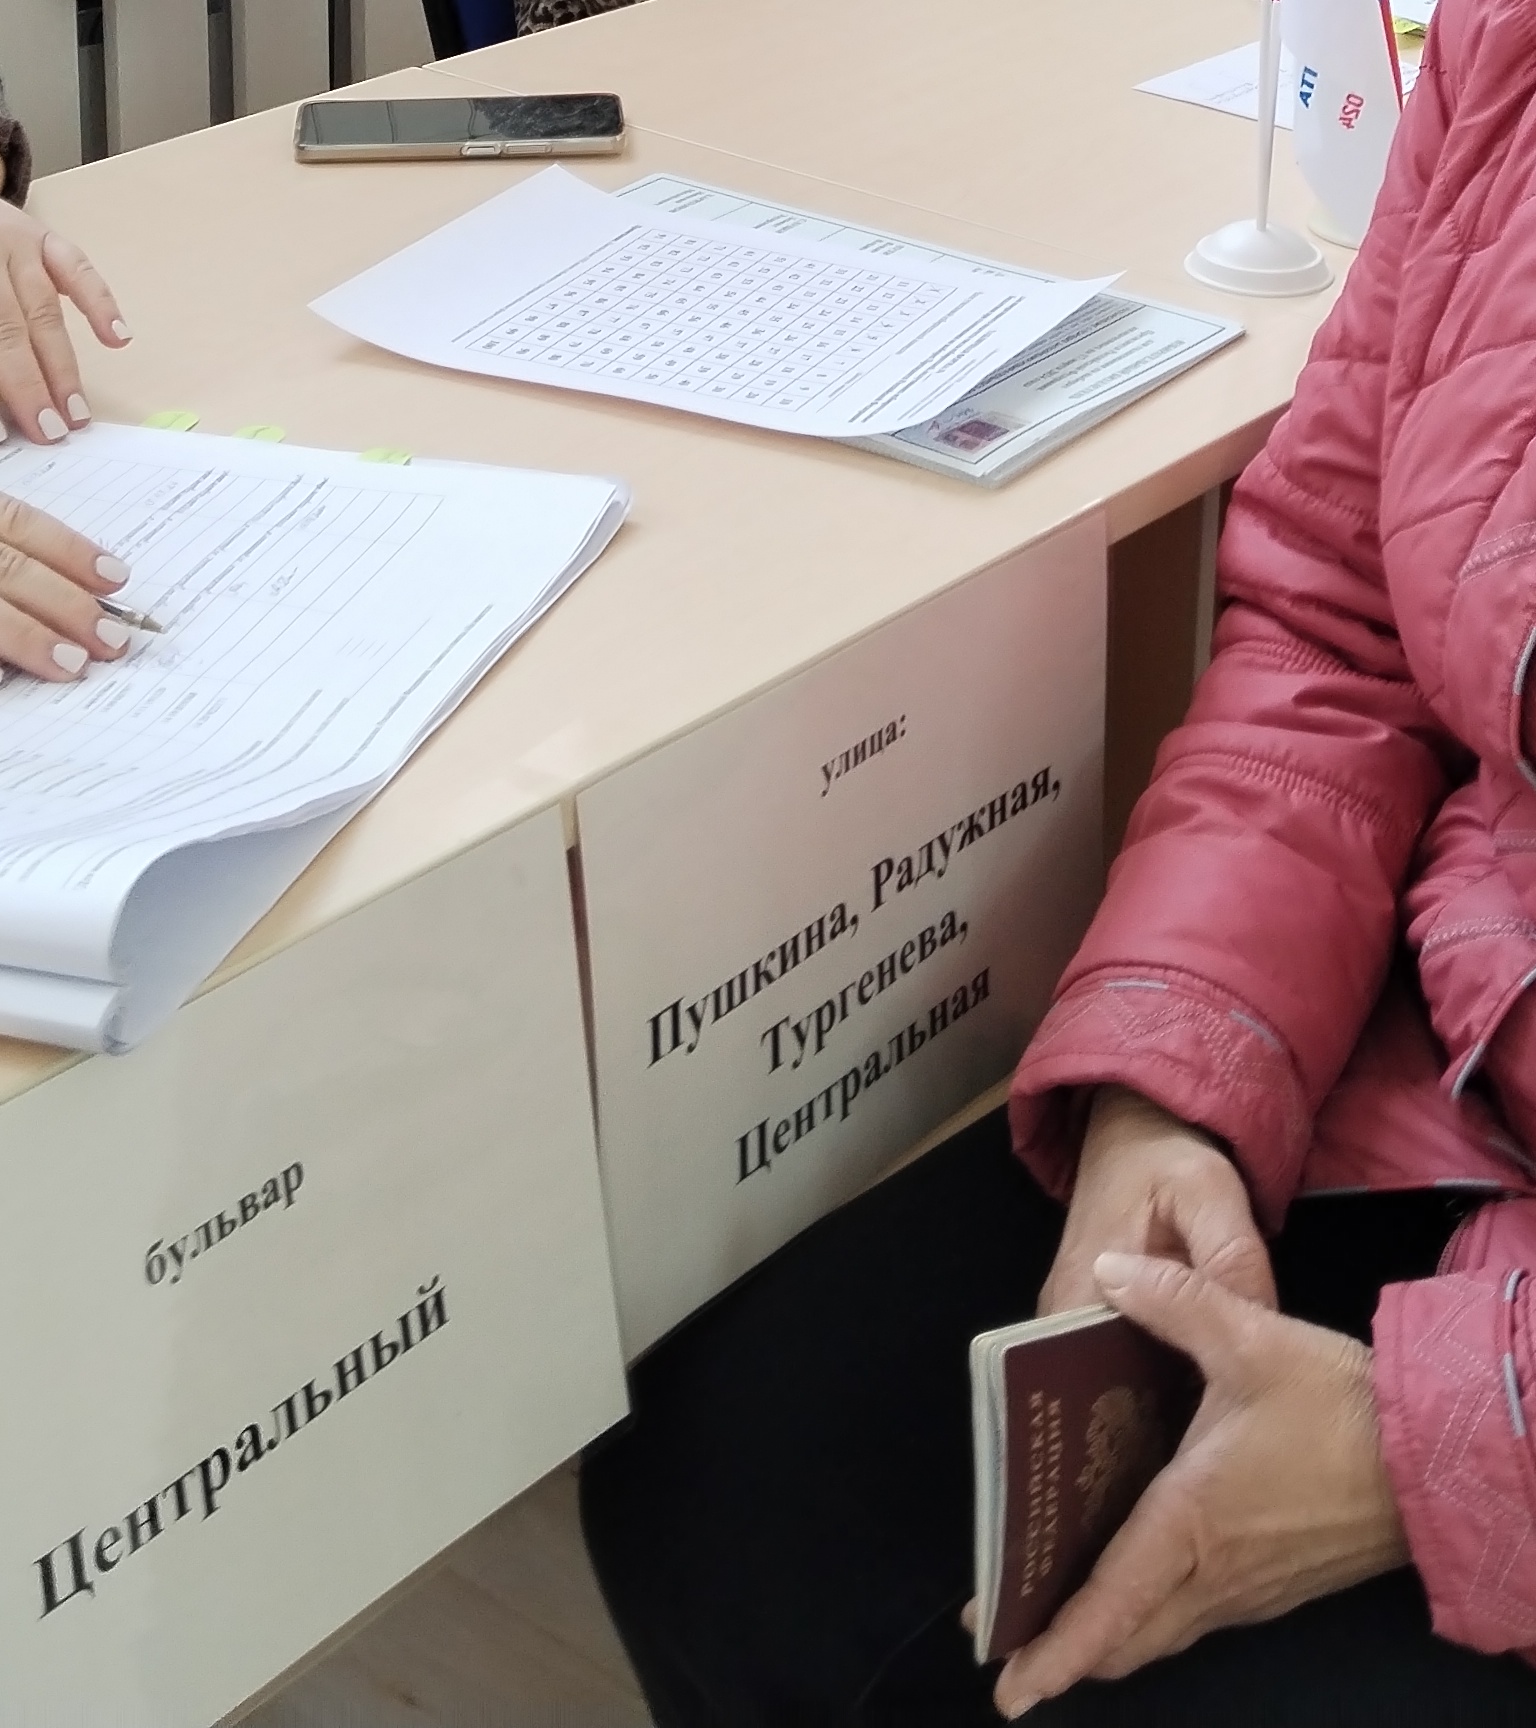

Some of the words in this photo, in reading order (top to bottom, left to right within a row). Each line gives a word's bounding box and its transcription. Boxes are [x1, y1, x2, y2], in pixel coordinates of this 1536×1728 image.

[819, 713, 908, 798] улица:
[645, 901, 860, 1070] Пушкина,
[869, 764, 1061, 914] Радужная,
[759, 907, 970, 1075] Тургенева,
[735, 965, 992, 1186] Центральная
[143, 1158, 306, 1287] бульвар
[31, 1273, 451, 1620] Центральный
